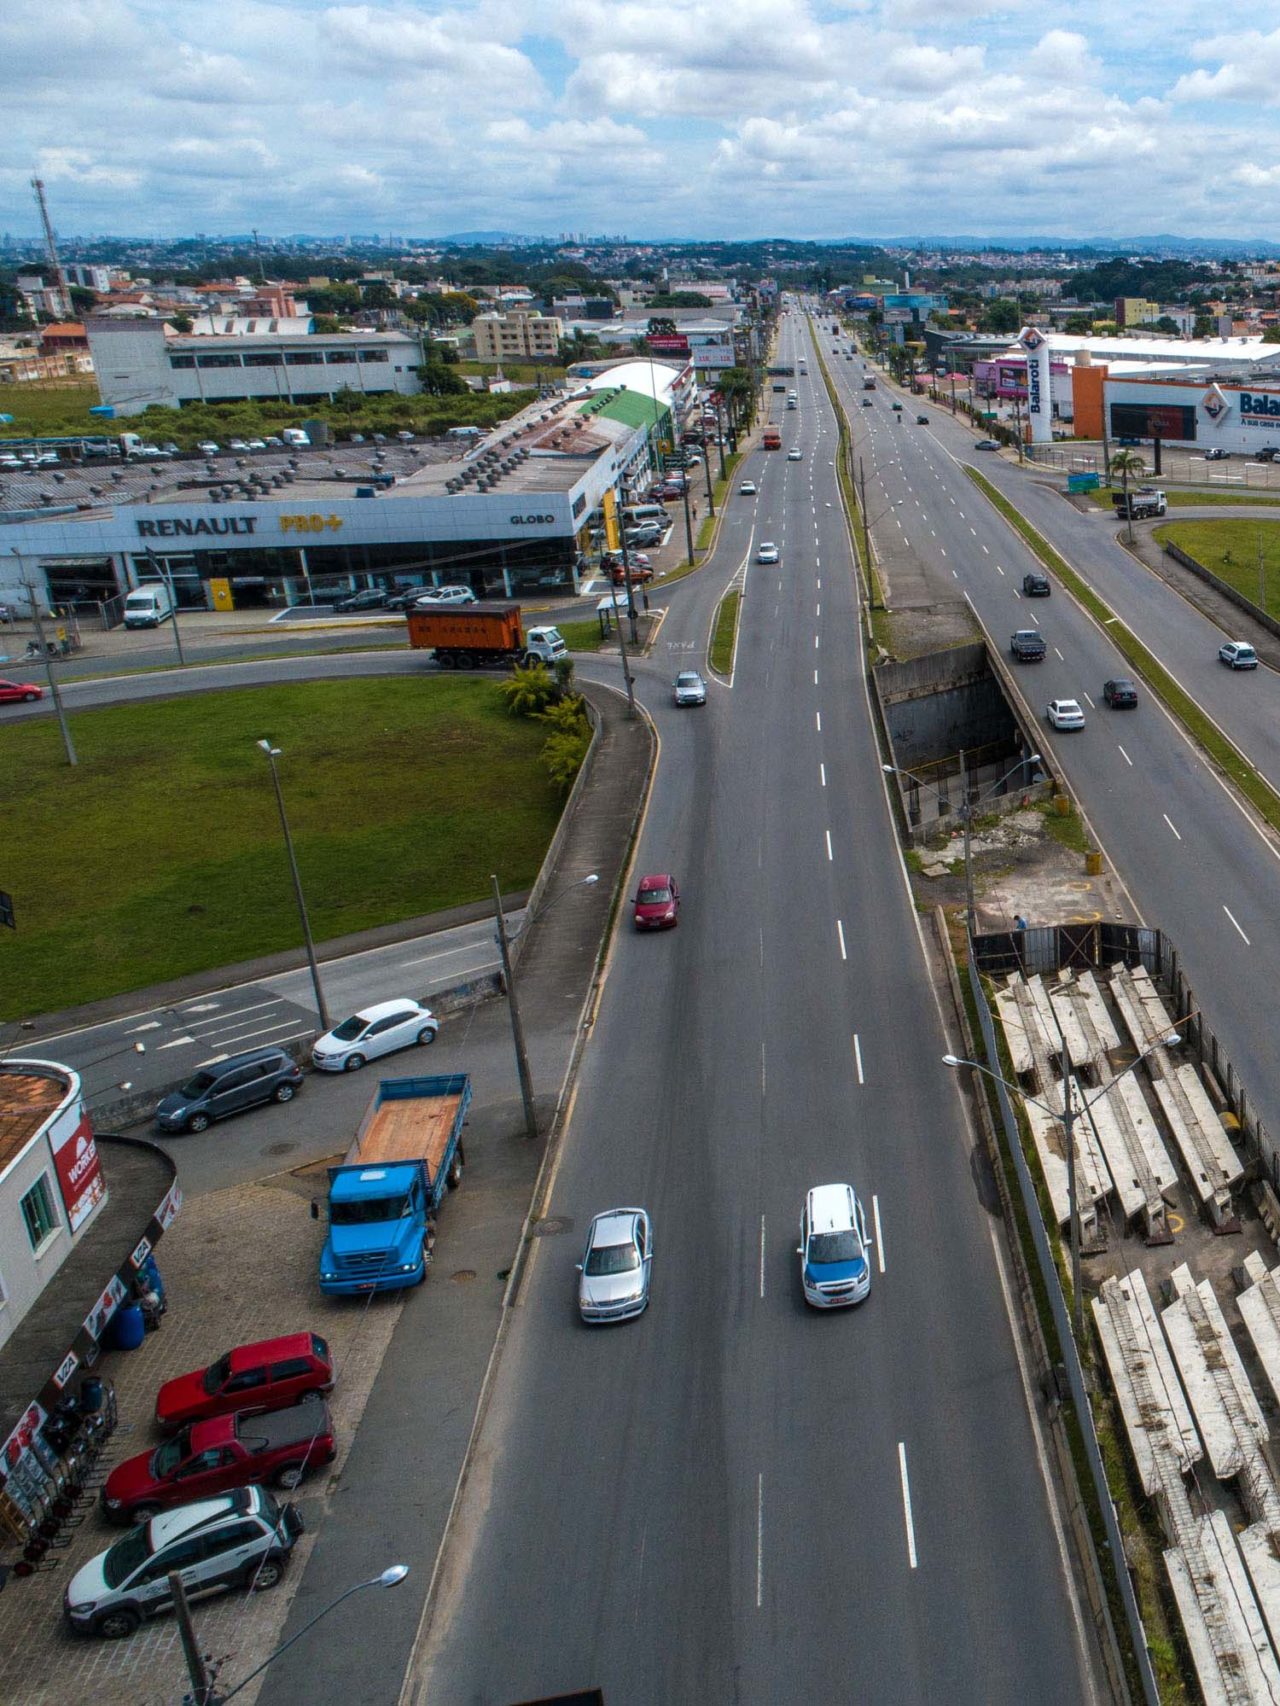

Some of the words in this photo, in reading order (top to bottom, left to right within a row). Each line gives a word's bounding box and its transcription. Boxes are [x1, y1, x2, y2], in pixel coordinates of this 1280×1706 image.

[1028, 359, 1041, 414] Balaroti
[1260, 421, 1275, 429] casa
[136, 516, 258, 537] RENAULT
[280, 513, 344, 534] PRO+
[510, 514, 555, 526] GLOBO
